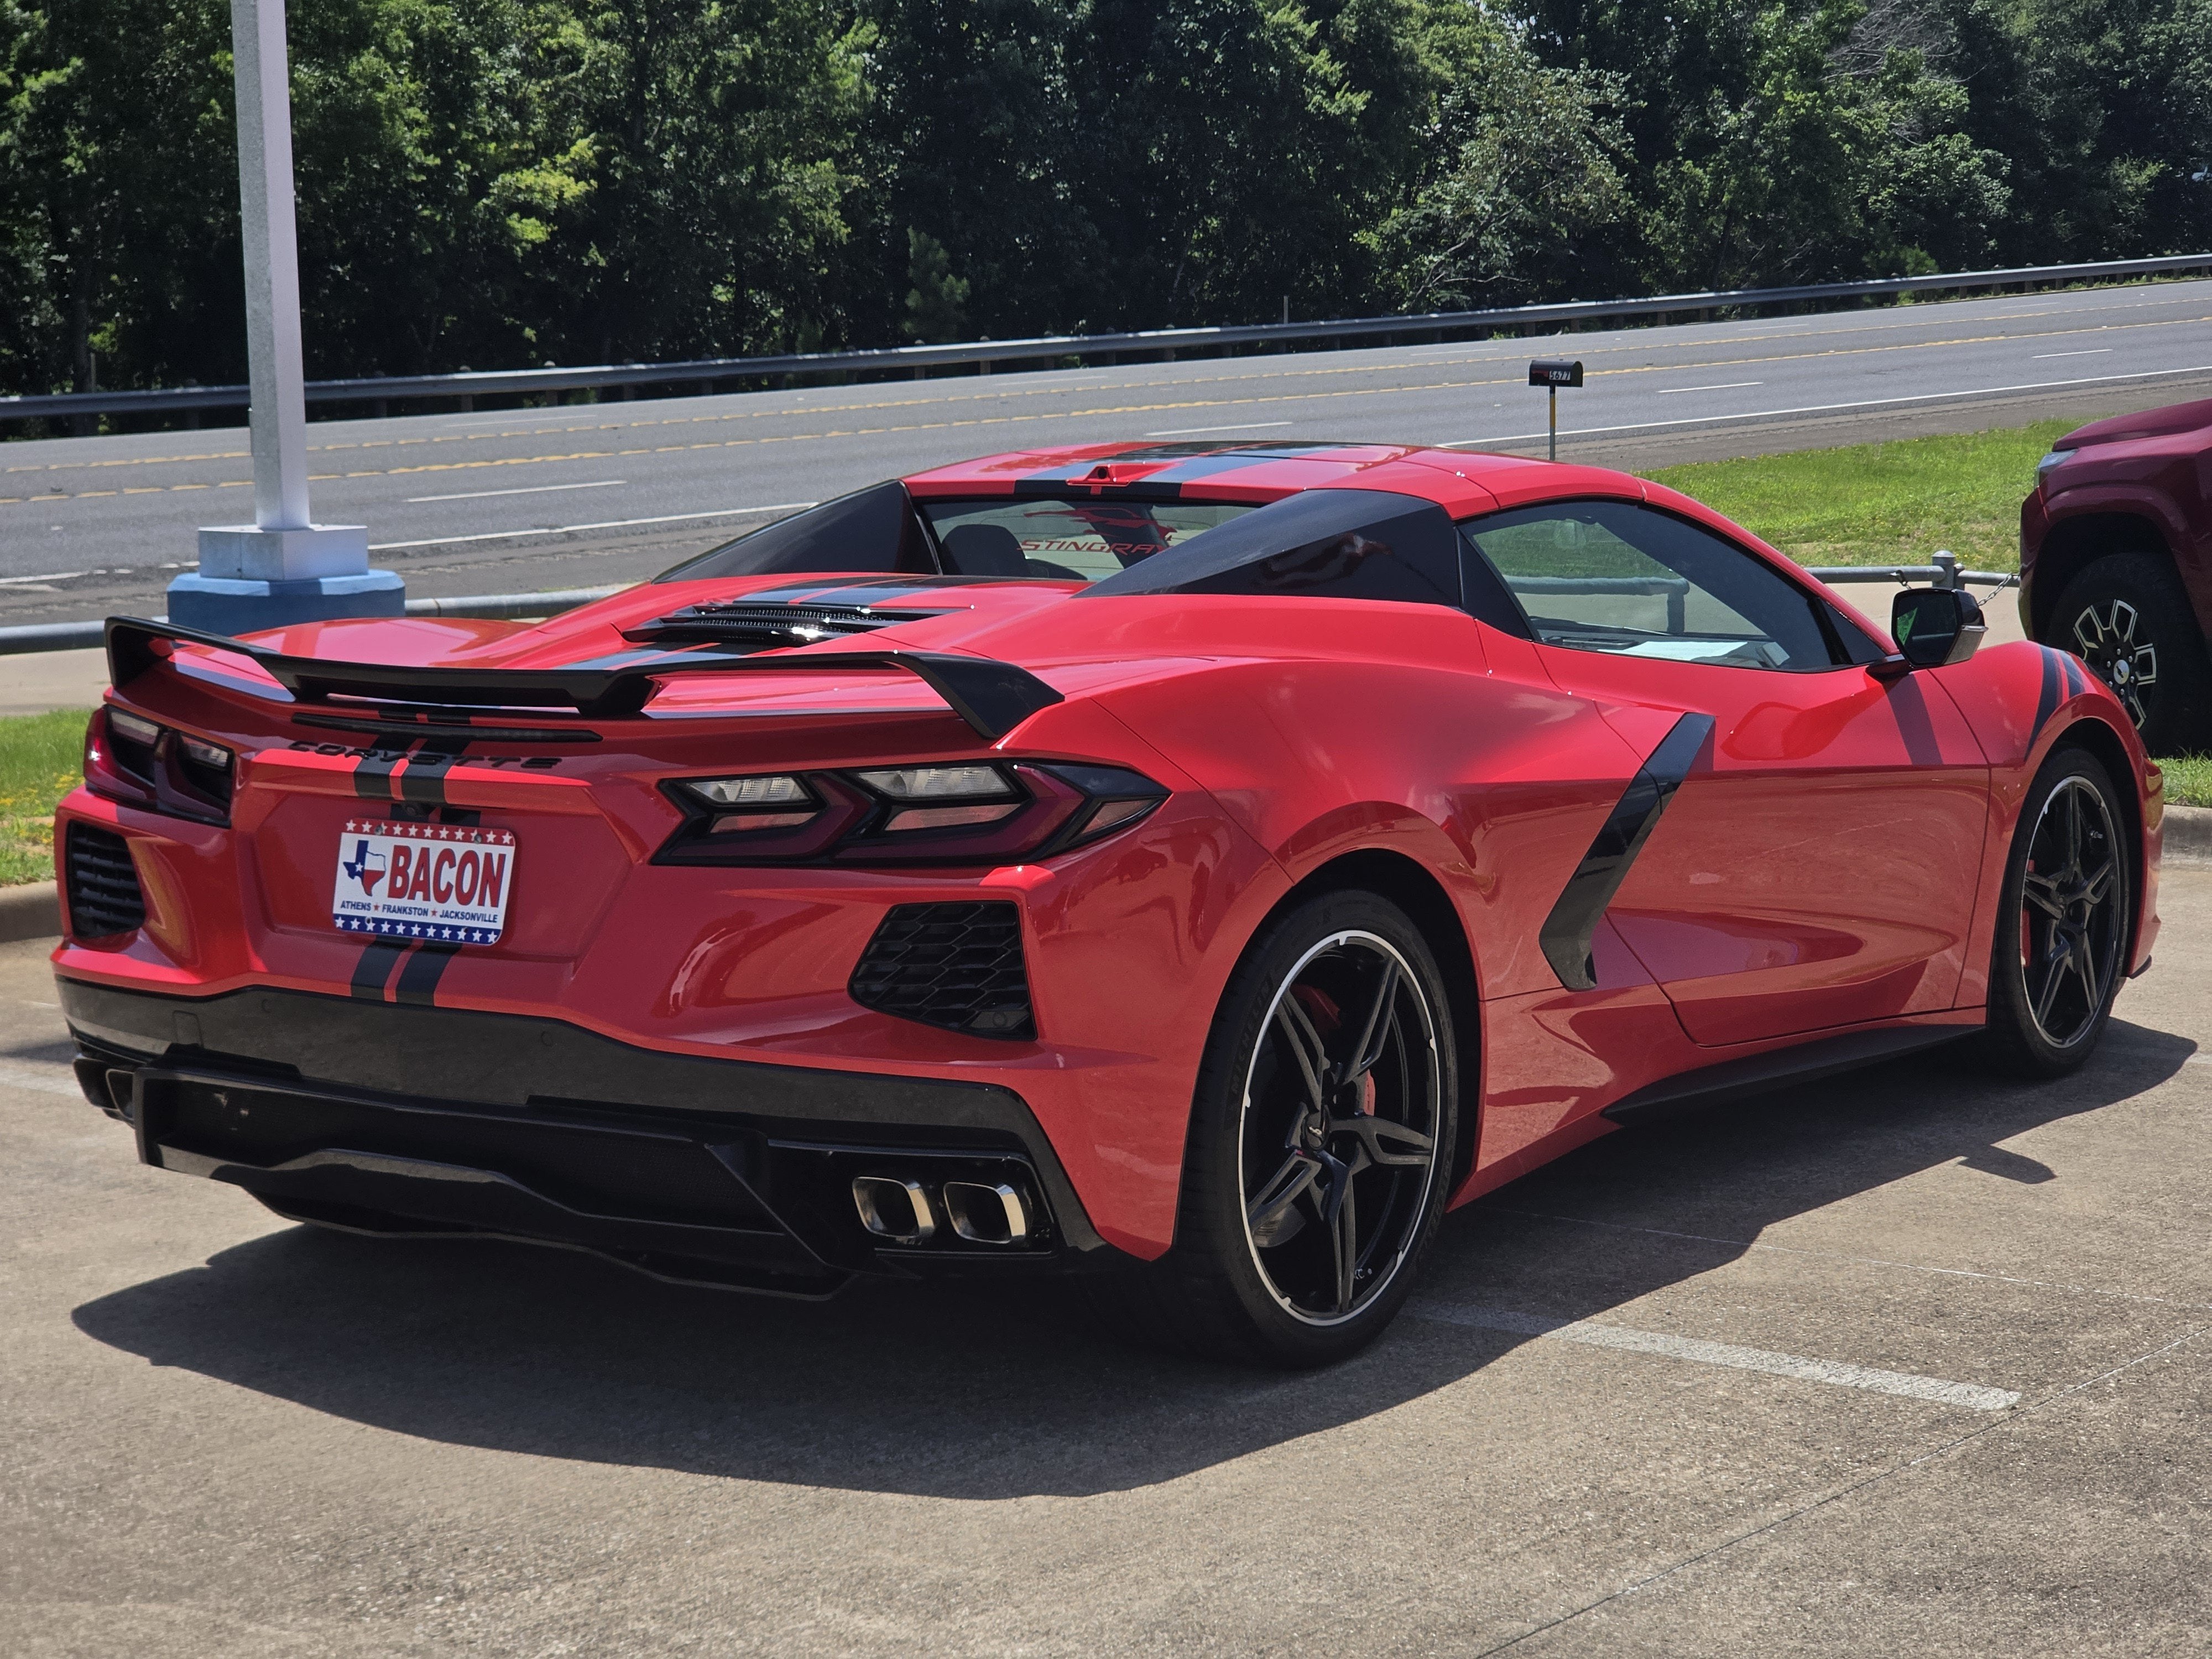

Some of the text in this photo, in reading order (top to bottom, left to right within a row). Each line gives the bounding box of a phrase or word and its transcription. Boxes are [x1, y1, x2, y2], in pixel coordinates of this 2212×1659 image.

[1550, 371, 1569, 379] 5677
[288, 740, 562, 768] CORVETTE
[388, 845, 506, 907] BACON
[341, 901, 498, 922] ATHENS FRANKSTON JACKSONVILLE
